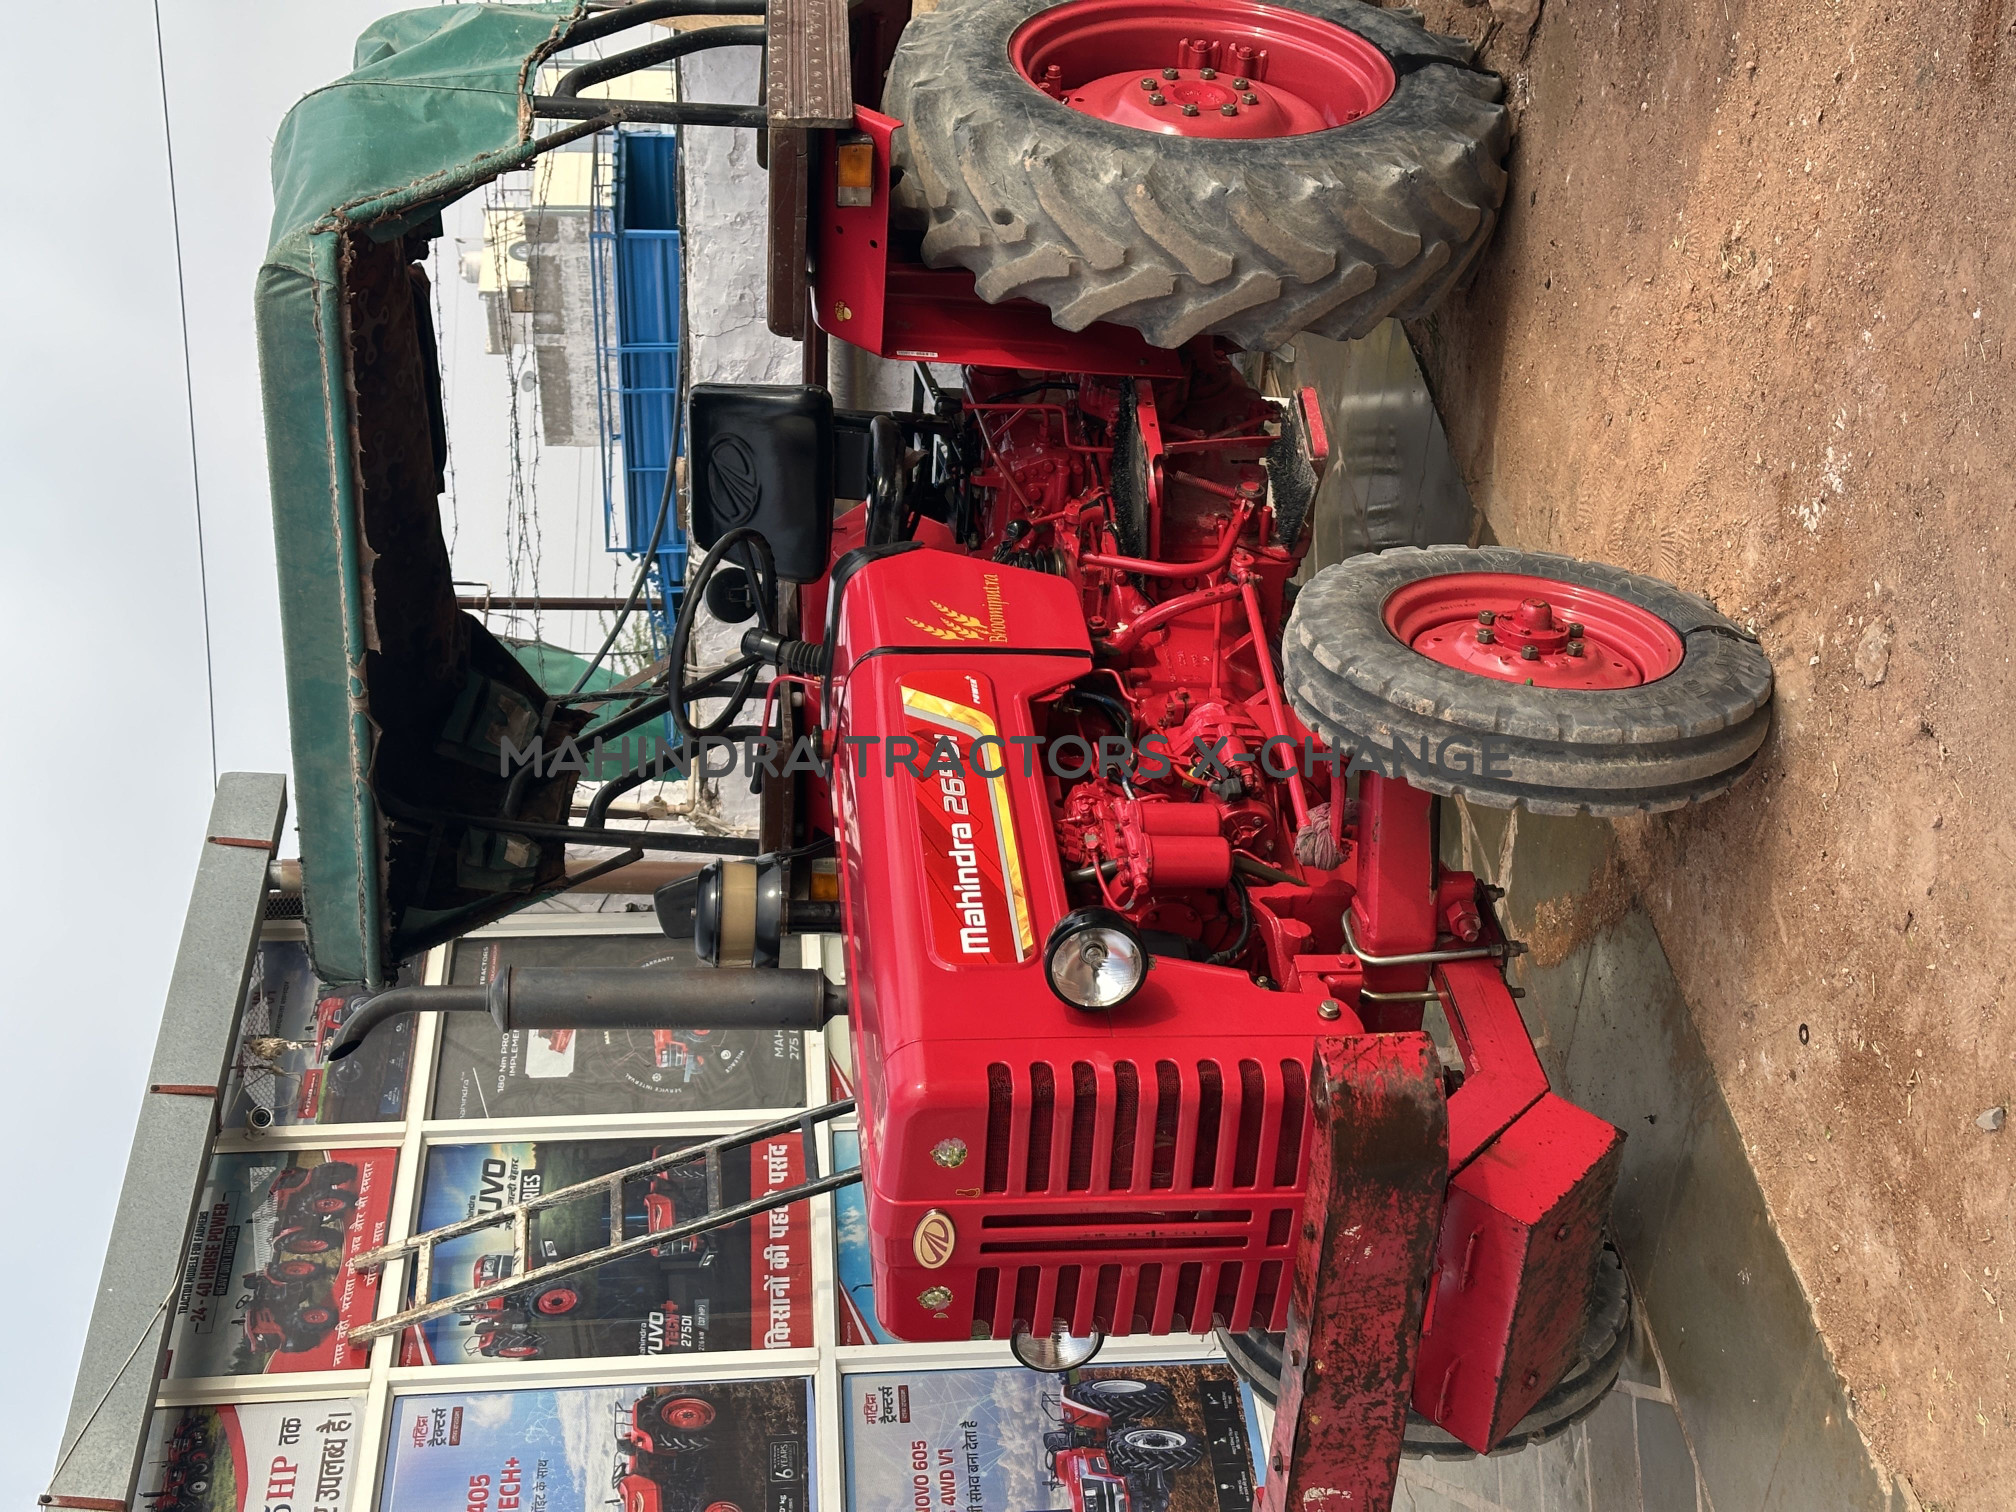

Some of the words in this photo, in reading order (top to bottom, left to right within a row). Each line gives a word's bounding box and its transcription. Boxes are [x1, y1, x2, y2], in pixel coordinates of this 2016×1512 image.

[982, 574, 1010, 643] Bhoomiputra
[948, 823, 990, 953] Mahindra
[480, 946, 489, 985] TRACTORS
[774, 1030, 784, 1057] MAH
[789, 1037, 799, 1060] 275
[499, 1057, 508, 1072] Nm
[497, 1075, 506, 1093] 180
[625, 1073, 653, 1090] INTERVAL
[763, 1143, 788, 1184] पसंद
[360, 1161, 374, 1194] दमदार
[522, 1175, 541, 1200] RIES
[354, 1196, 368, 1210] भी
[478, 1158, 506, 1228] UVO
[194, 1211, 208, 1241] FARMERS
[206, 1203, 229, 1242] POWER
[349, 1212, 365, 1232] और
[373, 1222, 385, 1243] साथ
[189, 1242, 202, 1255] FOR
[222, 1227, 238, 1257] TRACTORS
[350, 1235, 362, 1253] अब
[184, 1256, 199, 1283] MODELS
[198, 1244, 220, 1280] HORSE
[219, 1258, 232, 1273] DUTY
[763, 1243, 791, 1271] की
[195, 1282, 212, 1297] 40
[215, 1274, 228, 1293] HEAVY
[340, 1278, 356, 1312] भरोसा
[178, 1284, 193, 1314] TRACTOR
[763, 1274, 791, 1349] किसानों
[190, 1307, 207, 1322] 24
[639, 1322, 647, 1355] ahindra
[681, 1315, 692, 1347] 275DI
[333, 1343, 345, 1367] नाम
[278, 1417, 301, 1446] तक
[959, 1420, 977, 1428] है
[961, 1431, 978, 1450] देता
[780, 1444, 788, 1468] YEARS
[912, 1440, 928, 1470] 605
[938, 1449, 955, 1466] V1
[966, 1453, 979, 1473] बना
[315, 1438, 348, 1502] उपलब्ध
[536, 1459, 549, 1479] साथ
[775, 1468, 793, 1478] 6
[467, 1475, 491, 1512] 405
[498, 1457, 522, 1512] ECH+
[533, 1481, 547, 1491] के
[939, 1469, 957, 1505] 4WD
[966, 1476, 982, 1502] संभव
